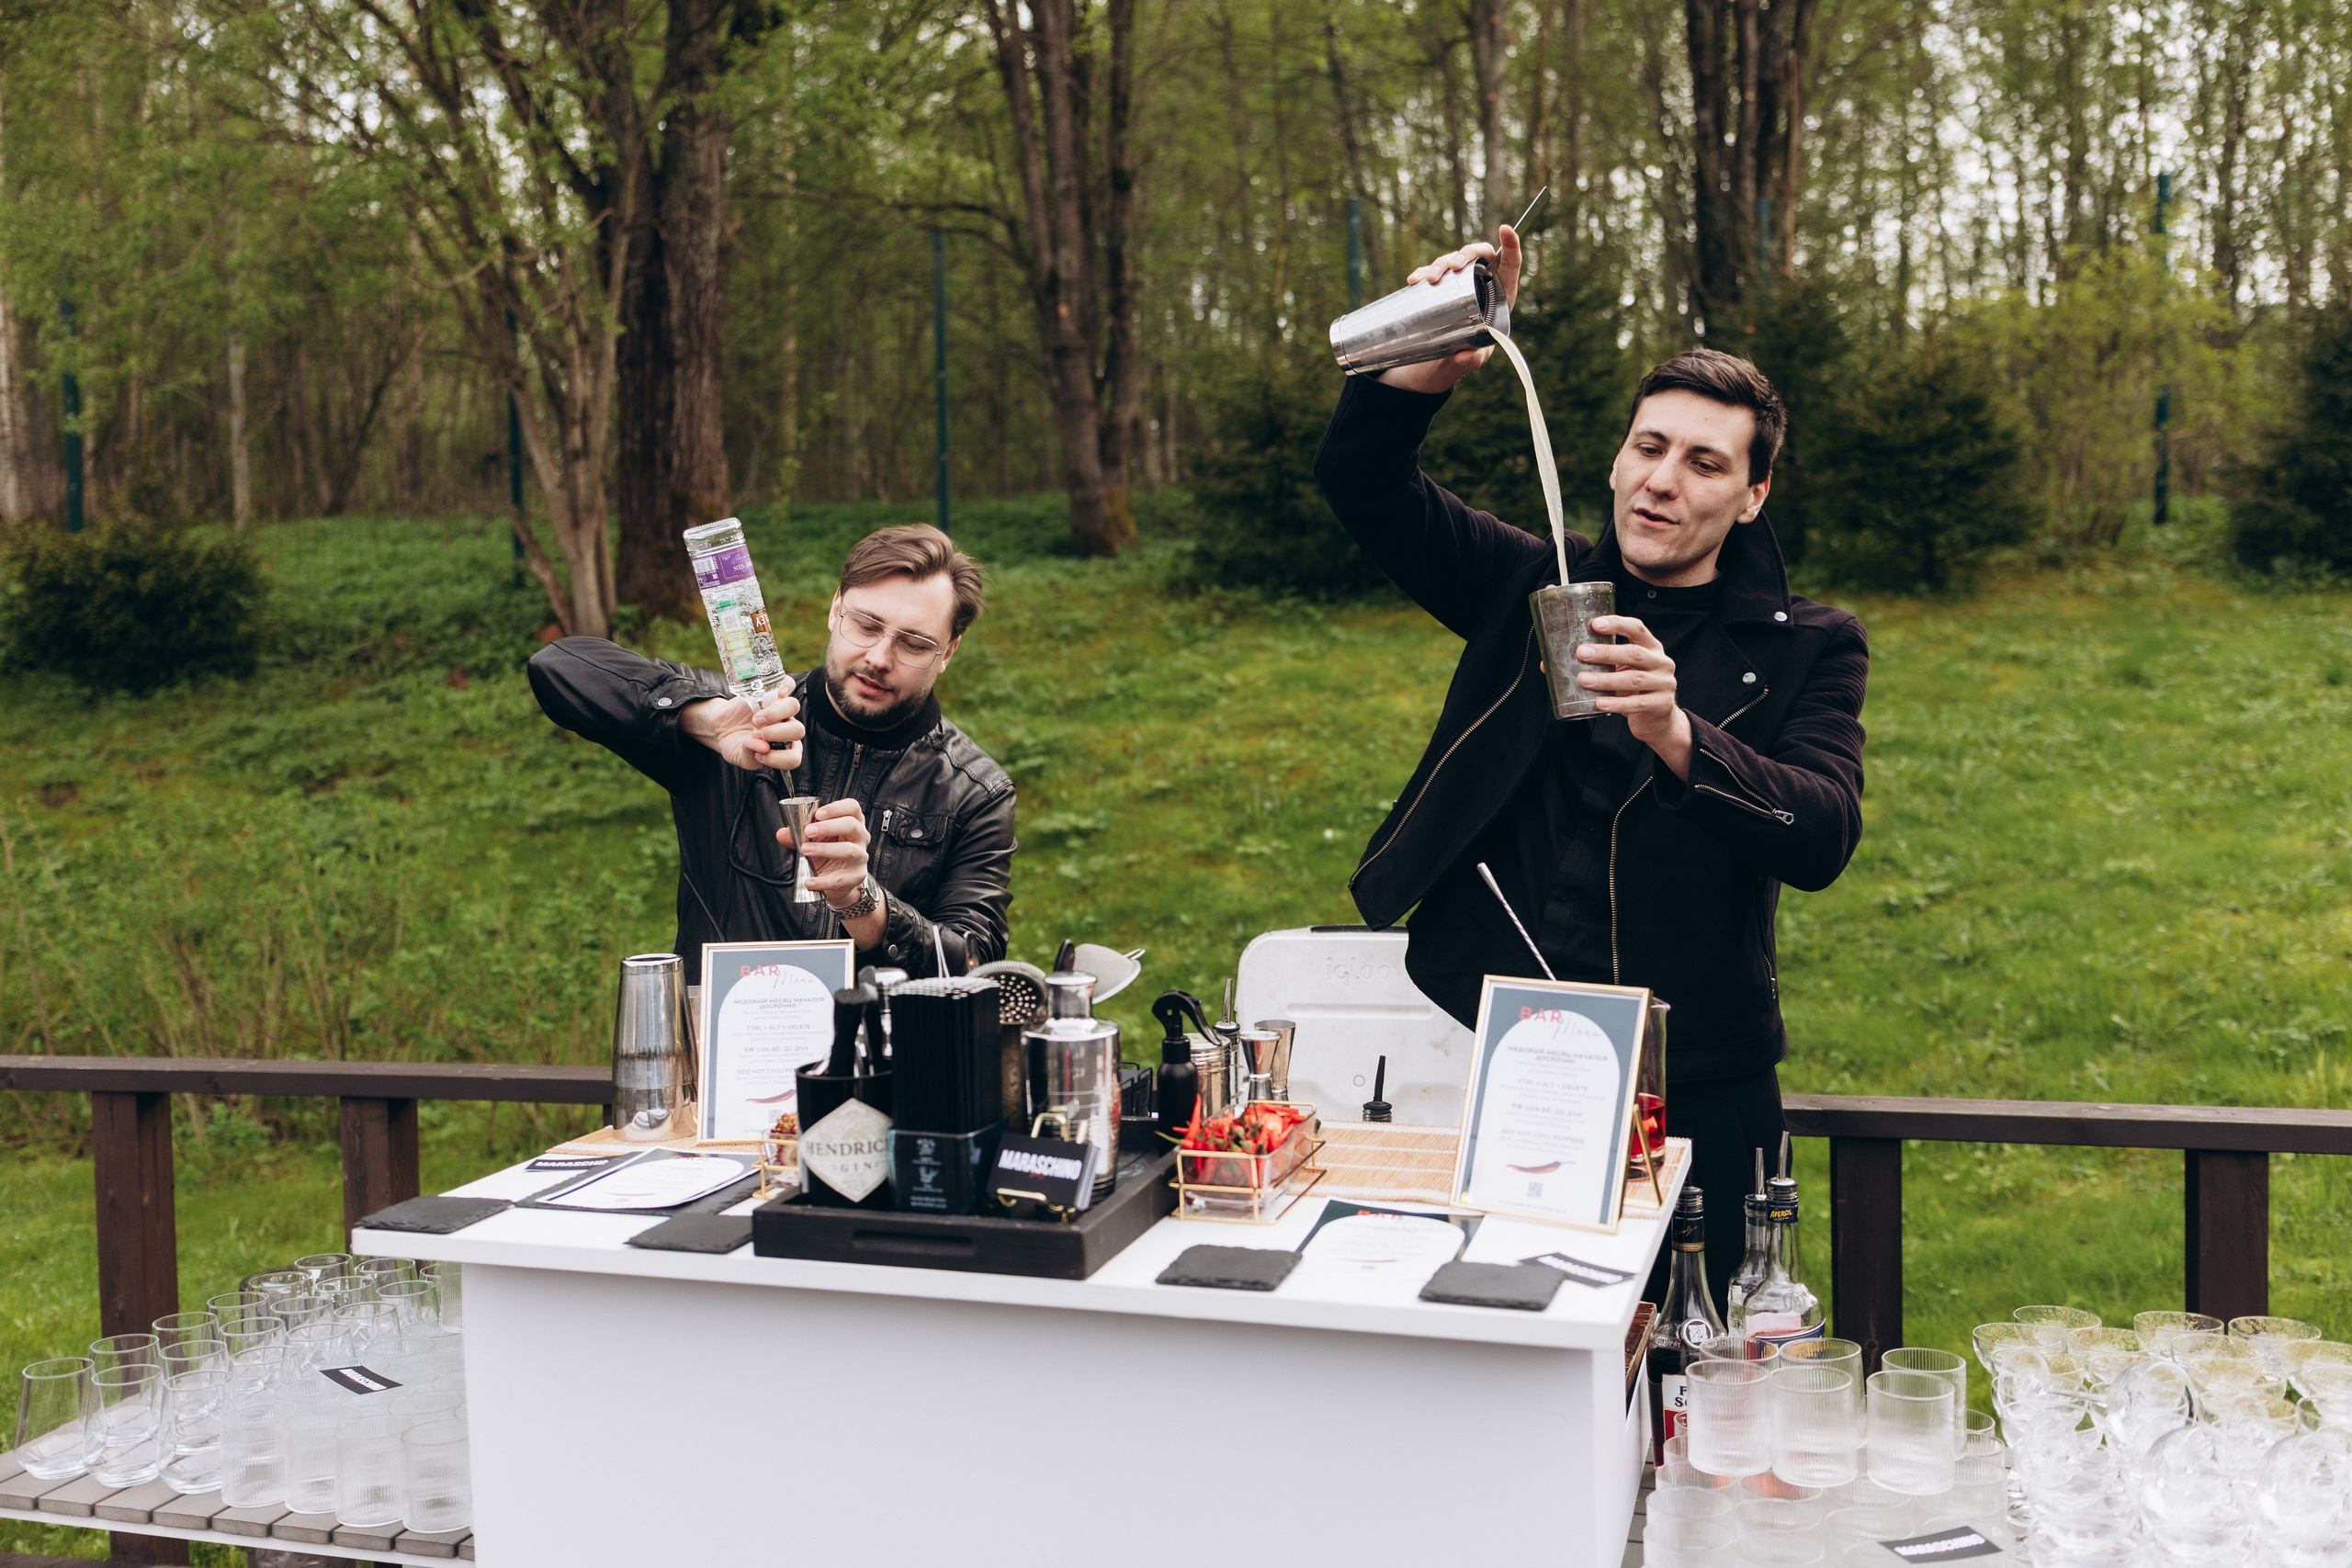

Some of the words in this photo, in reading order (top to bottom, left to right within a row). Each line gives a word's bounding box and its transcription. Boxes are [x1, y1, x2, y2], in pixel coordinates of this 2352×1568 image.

[741, 964, 779, 977] BAR
[773, 970, 815, 989] Menu
[1326, 957, 1391, 986] igloo
[1519, 1006, 1562, 1024] BAR
[1553, 1017, 1601, 1039] Menu
[998, 1148, 1082, 1180] MARASCHINO
[1770, 1209, 1792, 1218] APEROL
